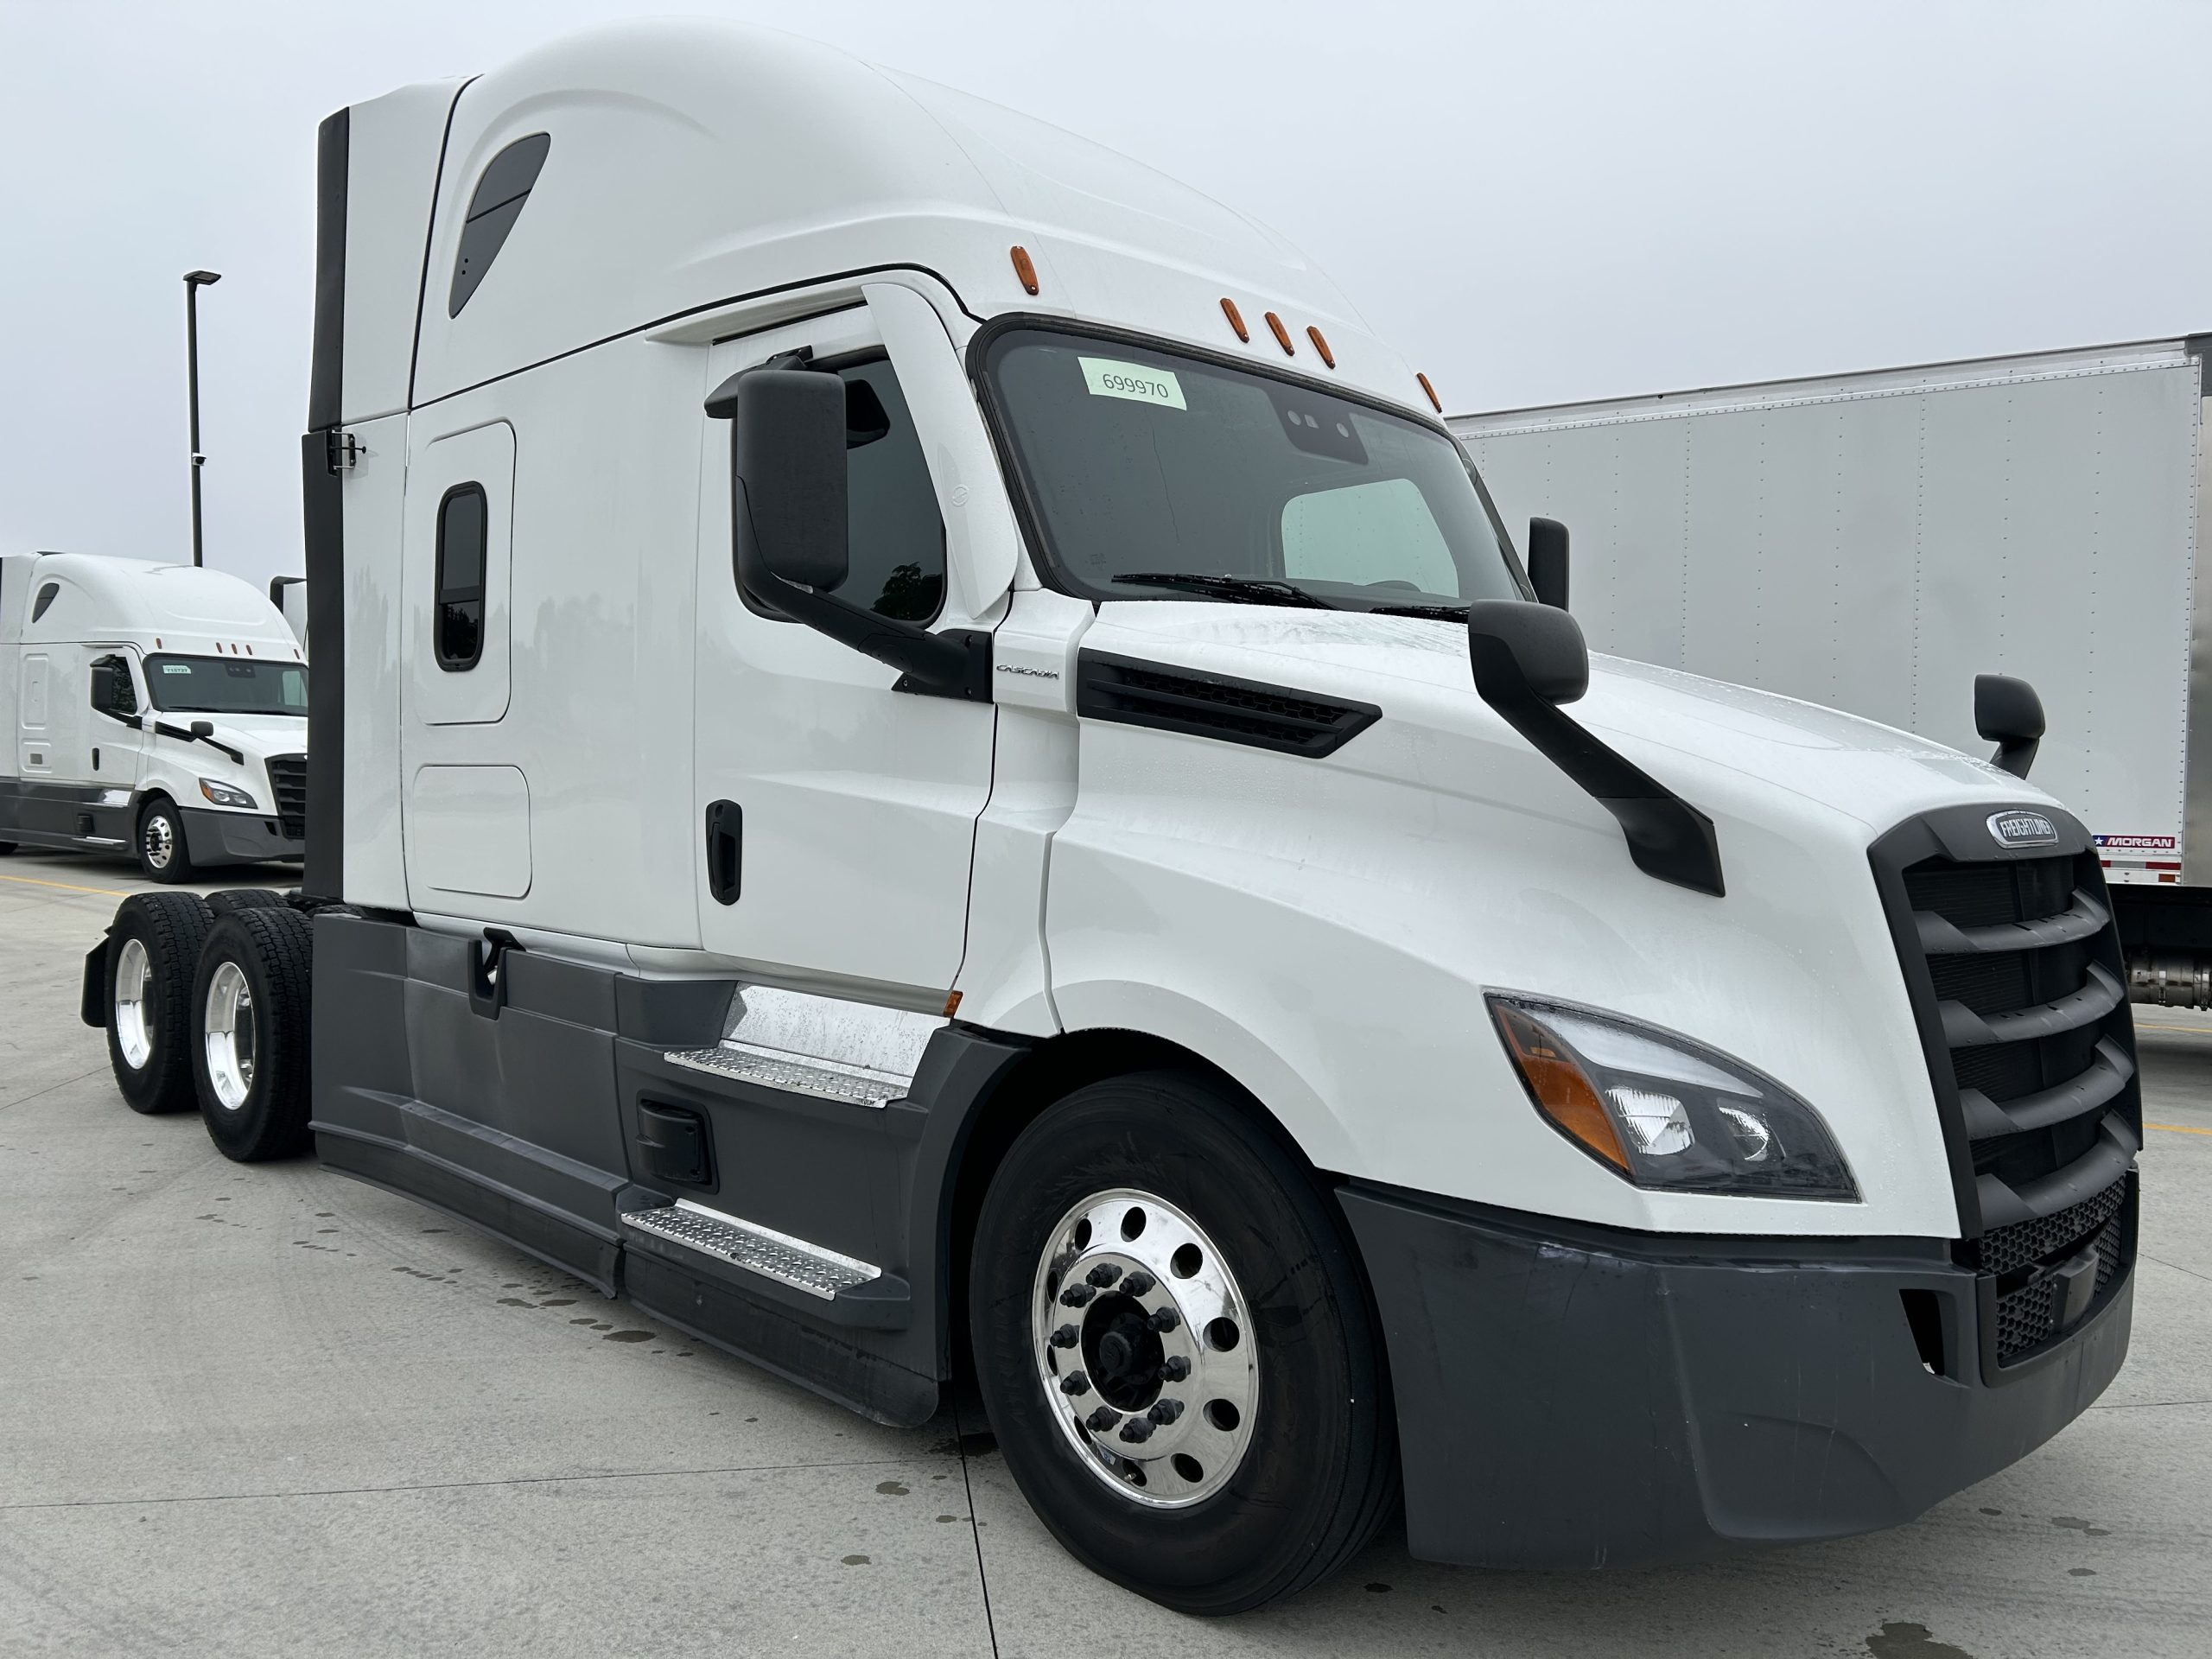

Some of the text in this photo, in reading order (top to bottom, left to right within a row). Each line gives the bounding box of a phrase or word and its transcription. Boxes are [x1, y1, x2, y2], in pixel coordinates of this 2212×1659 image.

[1103, 373, 1169, 398] 699970
[996, 664, 1059, 680] CASCADIA
[2000, 818, 2053, 836] FREIGHTLINER
[2107, 836, 2172, 847] MORGAN
